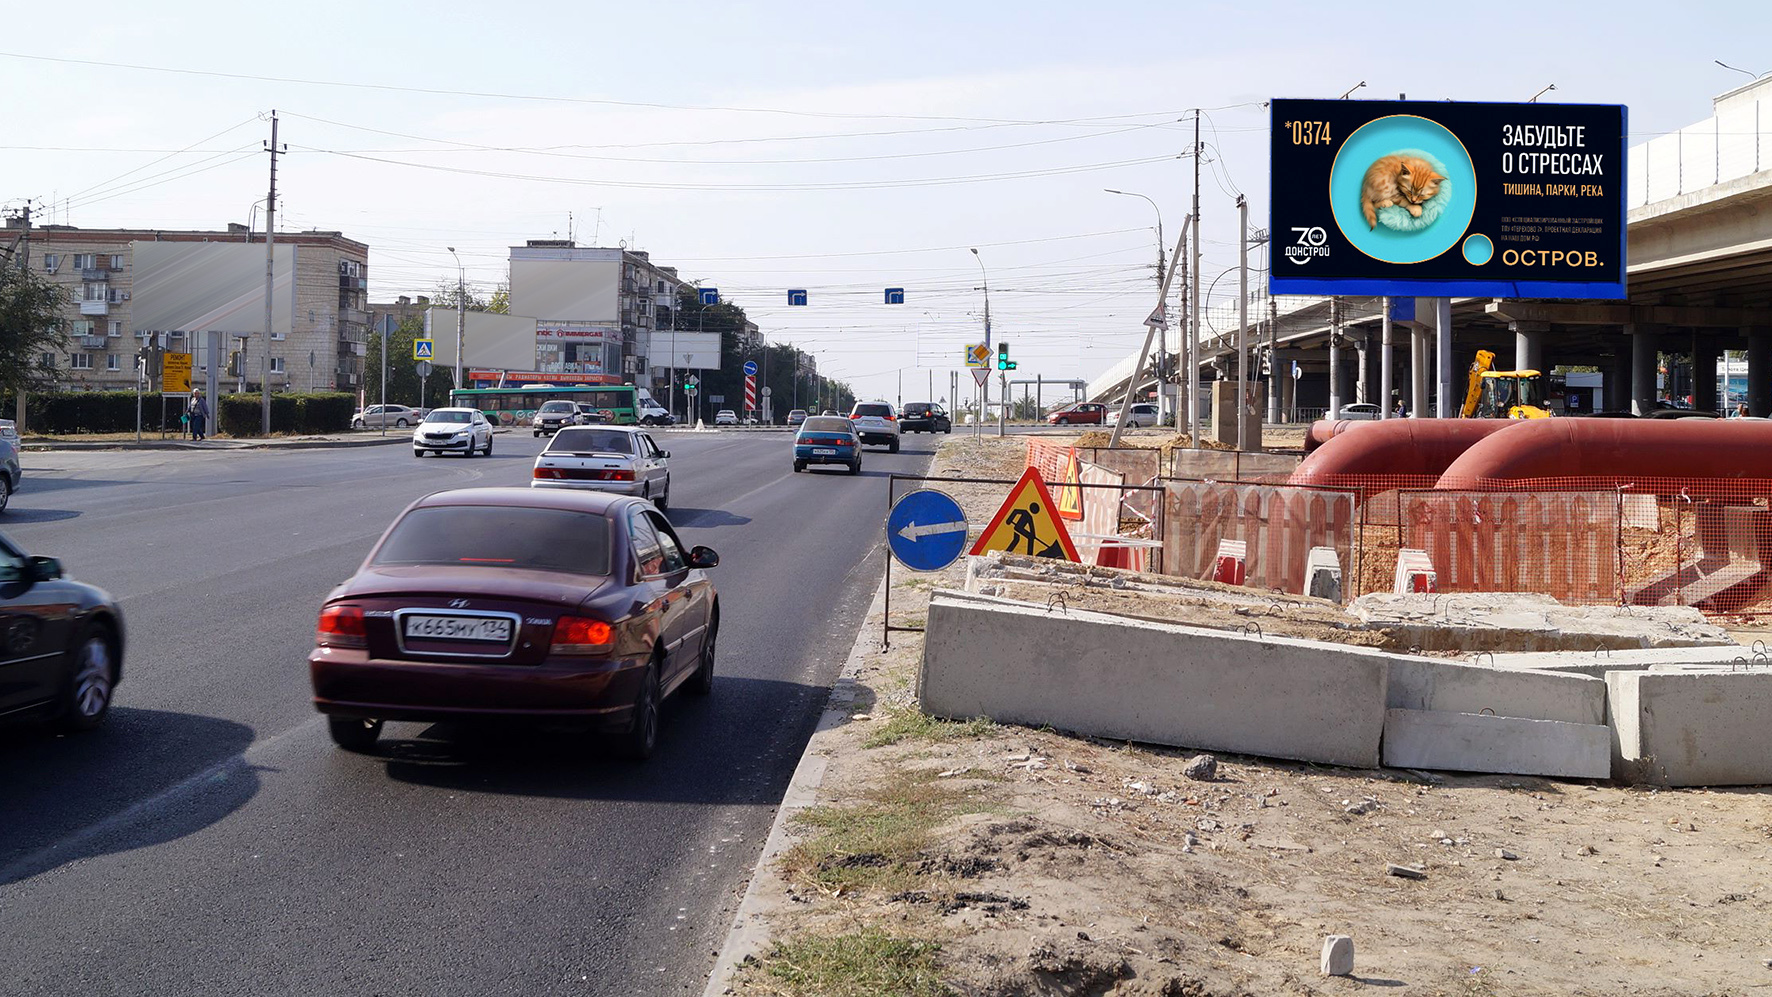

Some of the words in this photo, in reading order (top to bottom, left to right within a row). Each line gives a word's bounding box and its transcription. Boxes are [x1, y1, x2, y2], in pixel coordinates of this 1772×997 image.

[1502, 124, 1585, 149] ЗАБУДЬТЕ
[1502, 152, 1513, 174] О
[1518, 152, 1604, 175] СТРЕССАХ
[1503, 183, 1544, 197] ТИШИНА,
[1546, 184, 1579, 198] ПАРКИ,
[1580, 184, 1604, 197] РЕКА
[1284, 245, 1330, 257] ДОНСТРОЙ
[1502, 249, 1604, 267] ОСТРОВ.
[480, 620, 509, 636] 134
